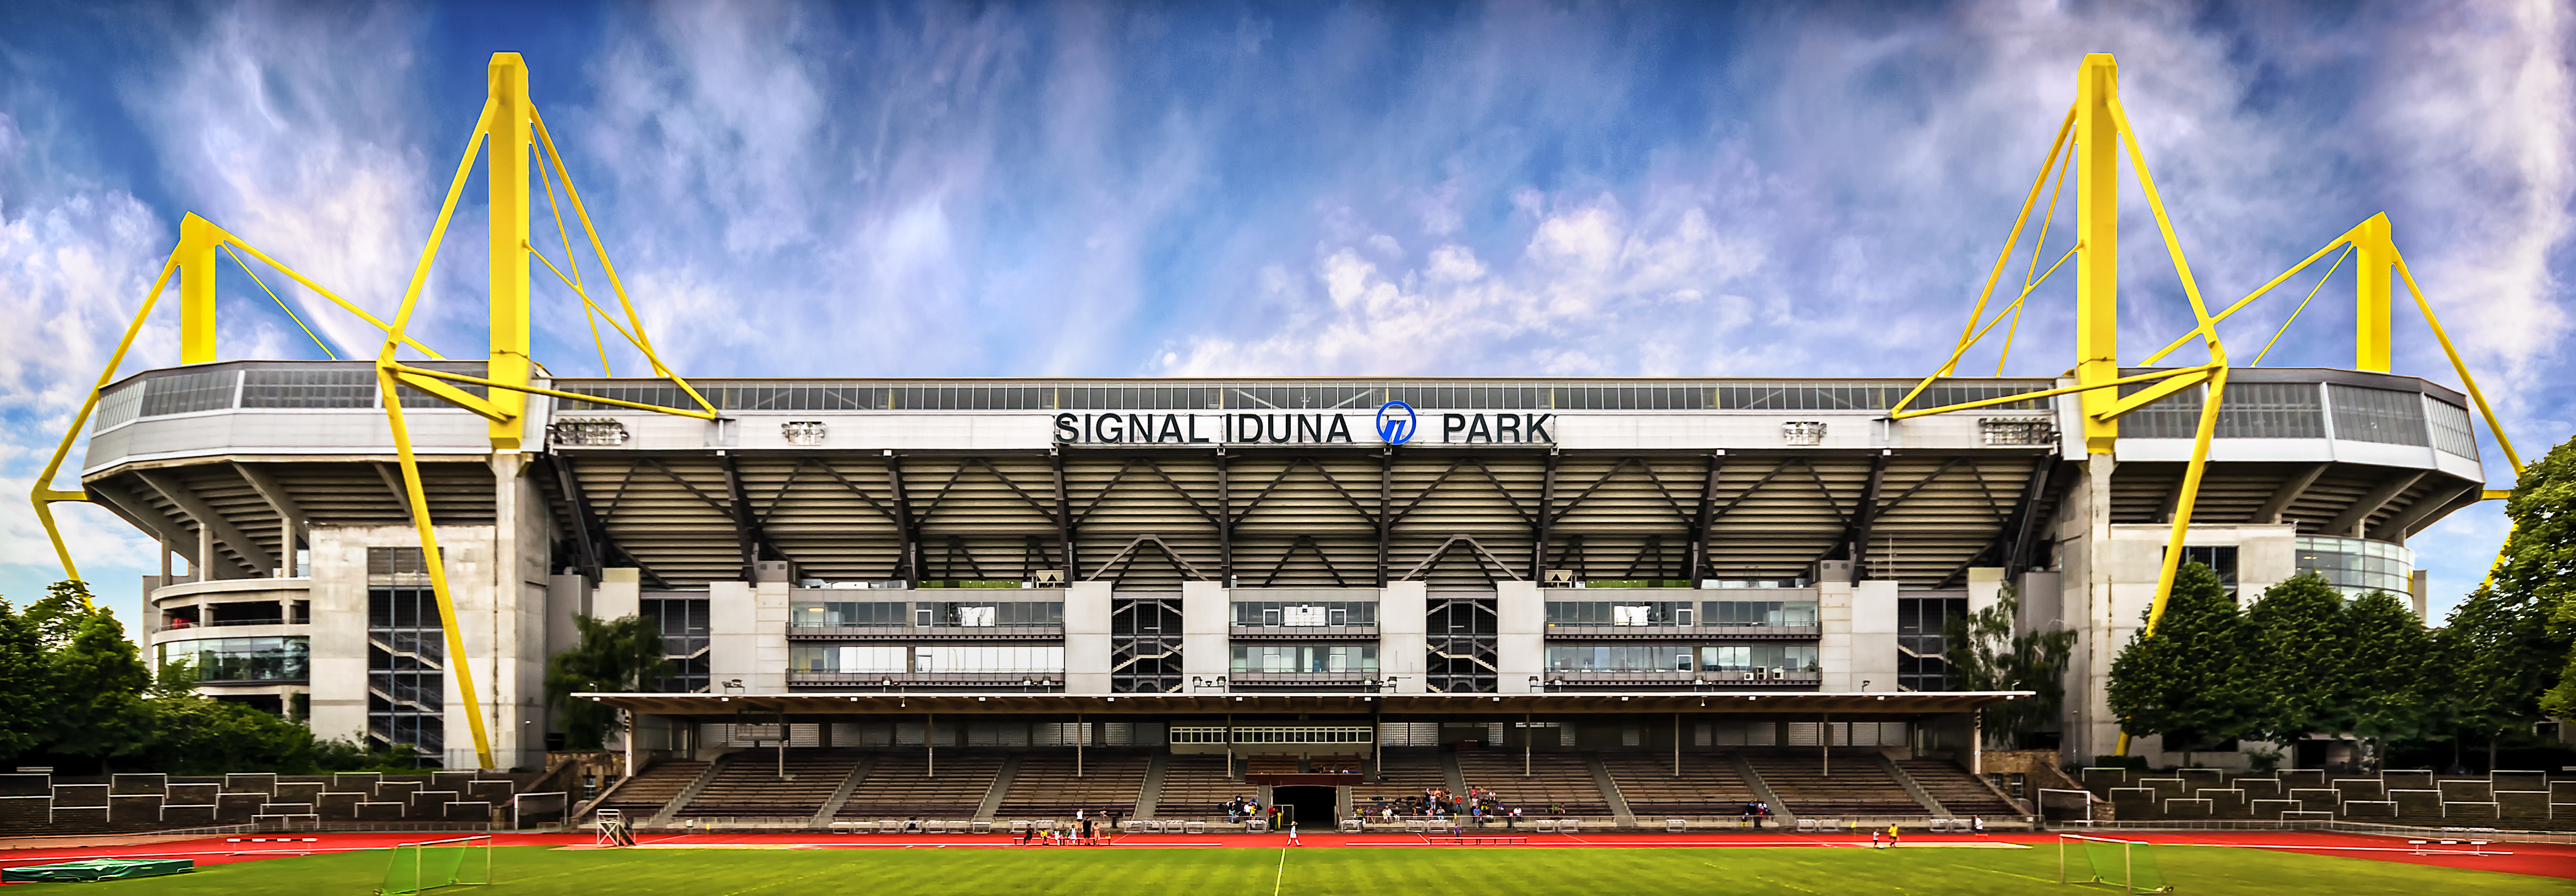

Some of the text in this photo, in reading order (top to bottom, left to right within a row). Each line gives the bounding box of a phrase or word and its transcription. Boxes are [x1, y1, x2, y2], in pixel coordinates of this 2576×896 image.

[1055, 413, 1553, 444] SIGNAL IDUNA PARK
